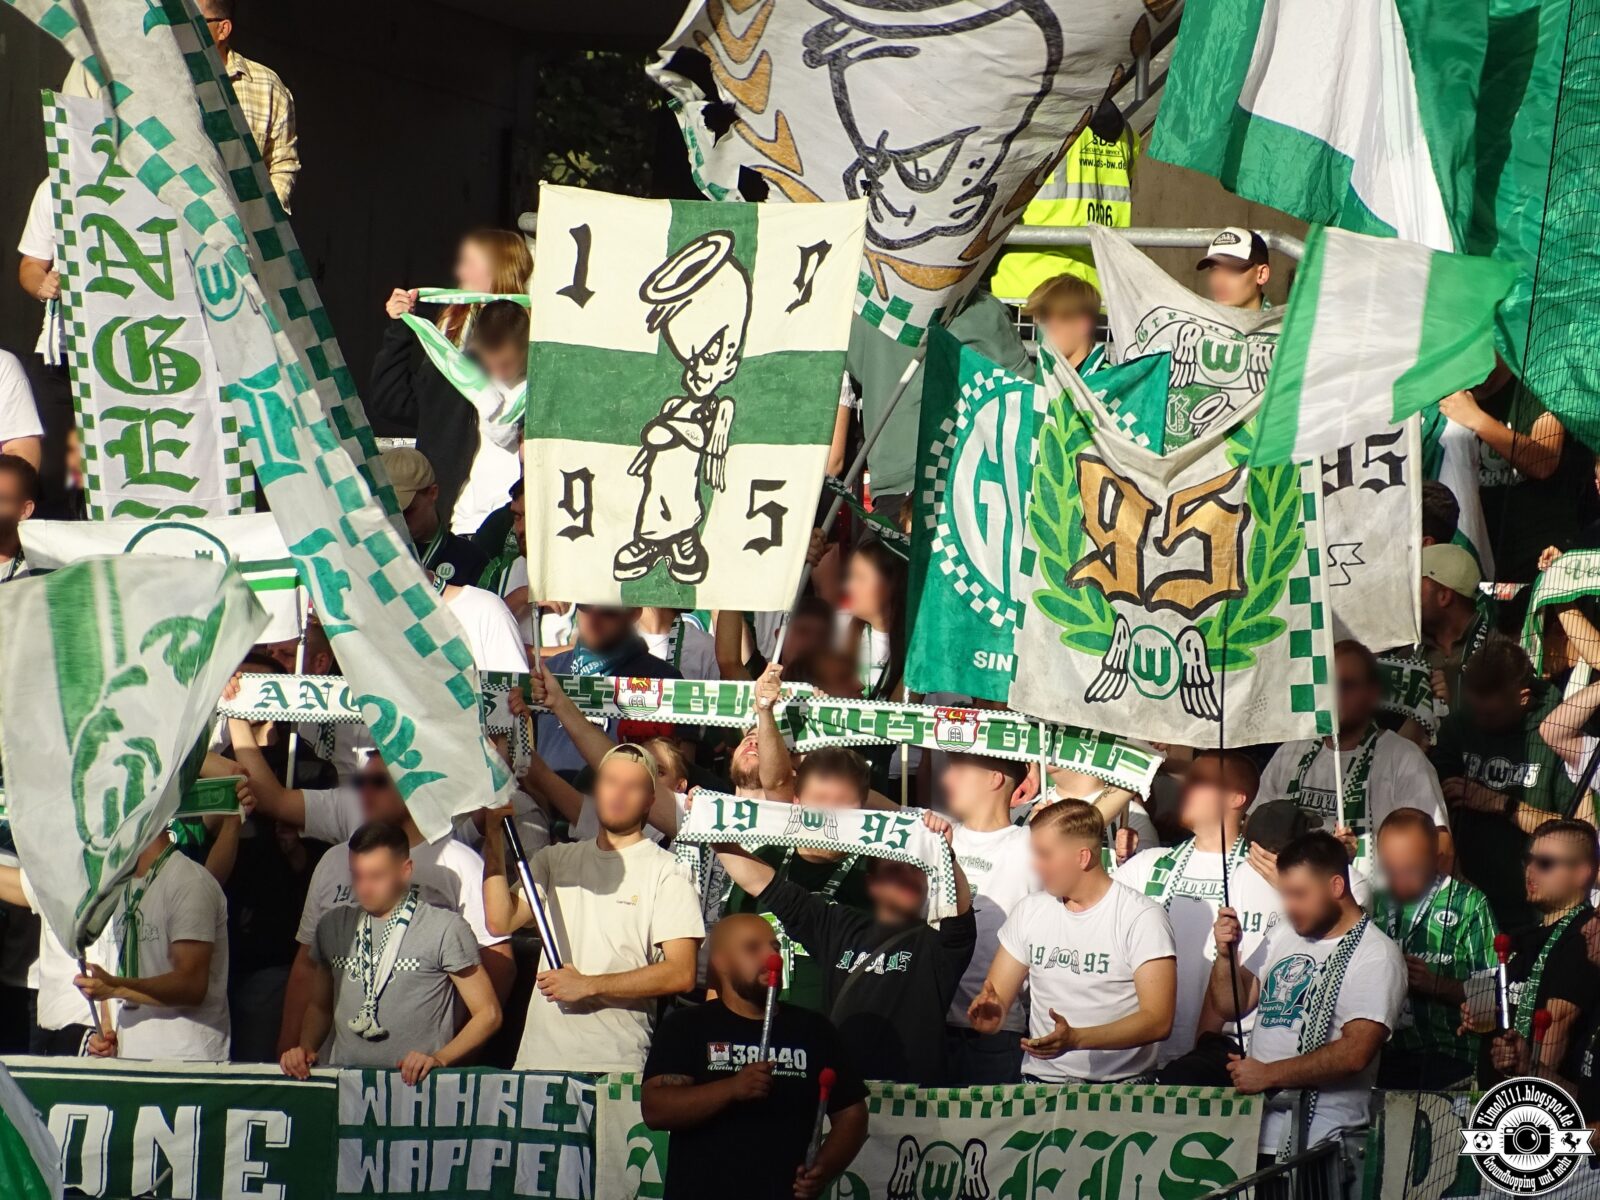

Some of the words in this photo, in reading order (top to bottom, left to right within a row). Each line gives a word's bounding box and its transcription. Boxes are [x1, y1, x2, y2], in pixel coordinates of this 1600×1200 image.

[742, 479, 789, 555] 5
[711, 798, 759, 832] 19
[859, 812, 918, 850] 95
[1242, 910, 1263, 933] 19
[1028, 943, 1046, 966] 19
[1083, 952, 1111, 974] 95
[336, 1138, 592, 1200] WAPPEN
